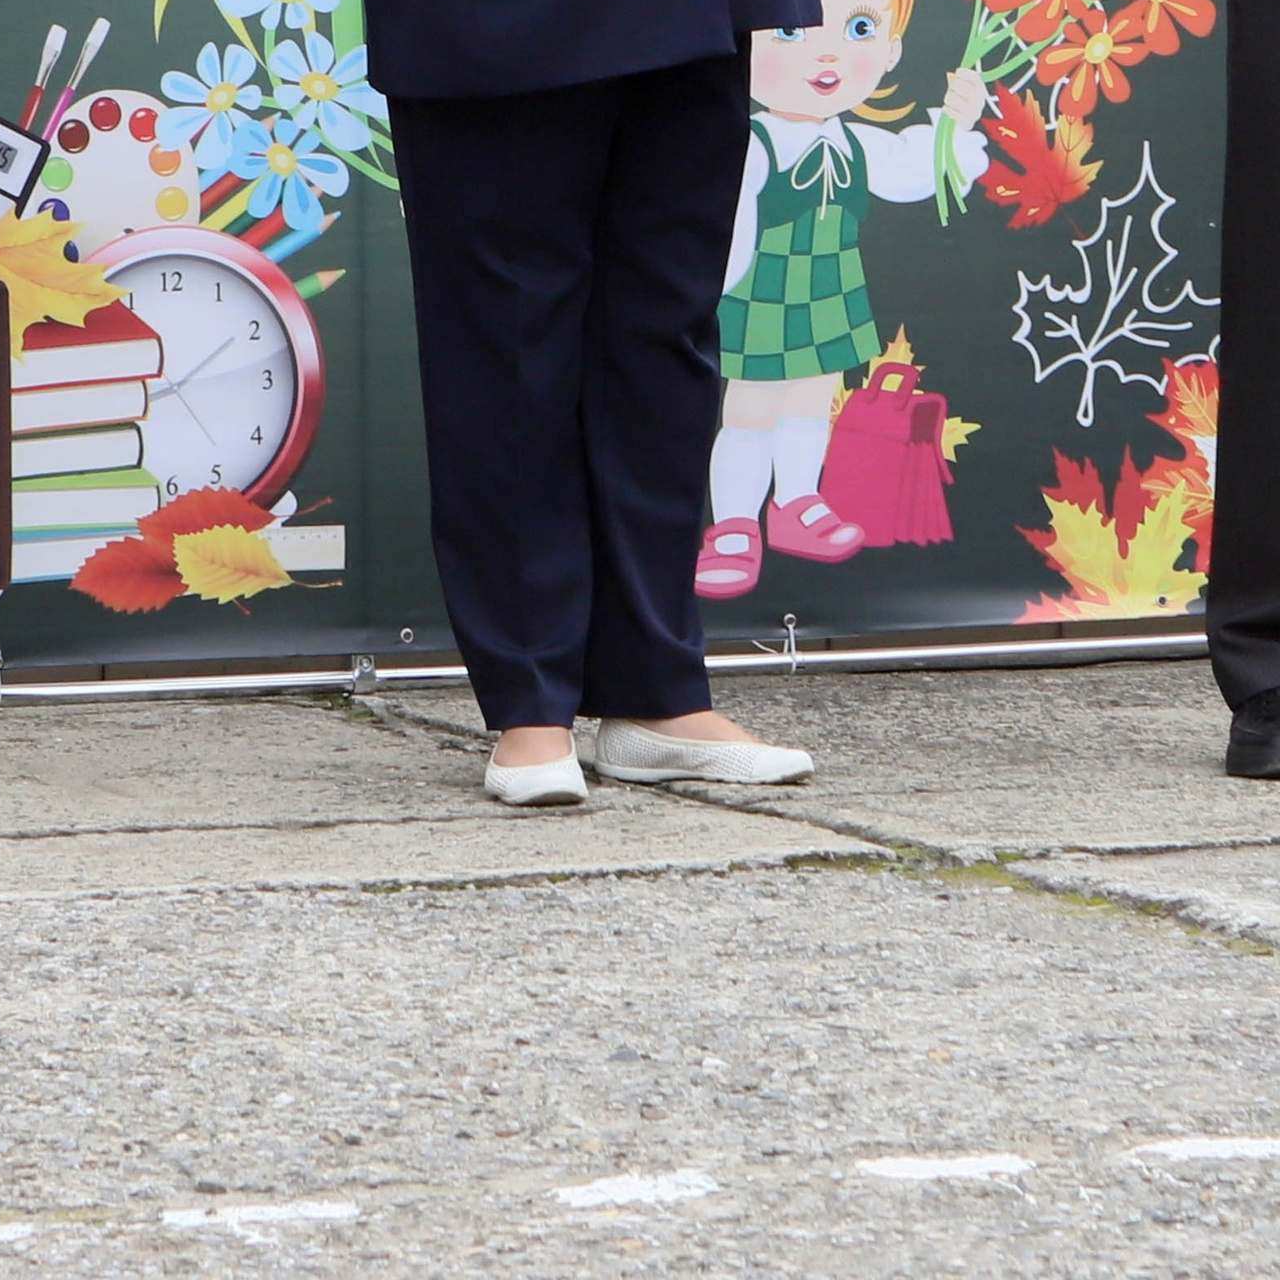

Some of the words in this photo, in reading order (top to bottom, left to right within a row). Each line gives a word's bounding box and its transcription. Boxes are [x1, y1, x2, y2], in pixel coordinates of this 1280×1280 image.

[160, 271, 183, 293] 12
[214, 282, 223, 302] 1
[248, 320, 261, 341] 2
[261, 369, 273, 390] 3
[250, 425, 263, 445] 4
[210, 464, 222, 485] 5
[166, 475, 178, 496] 6
